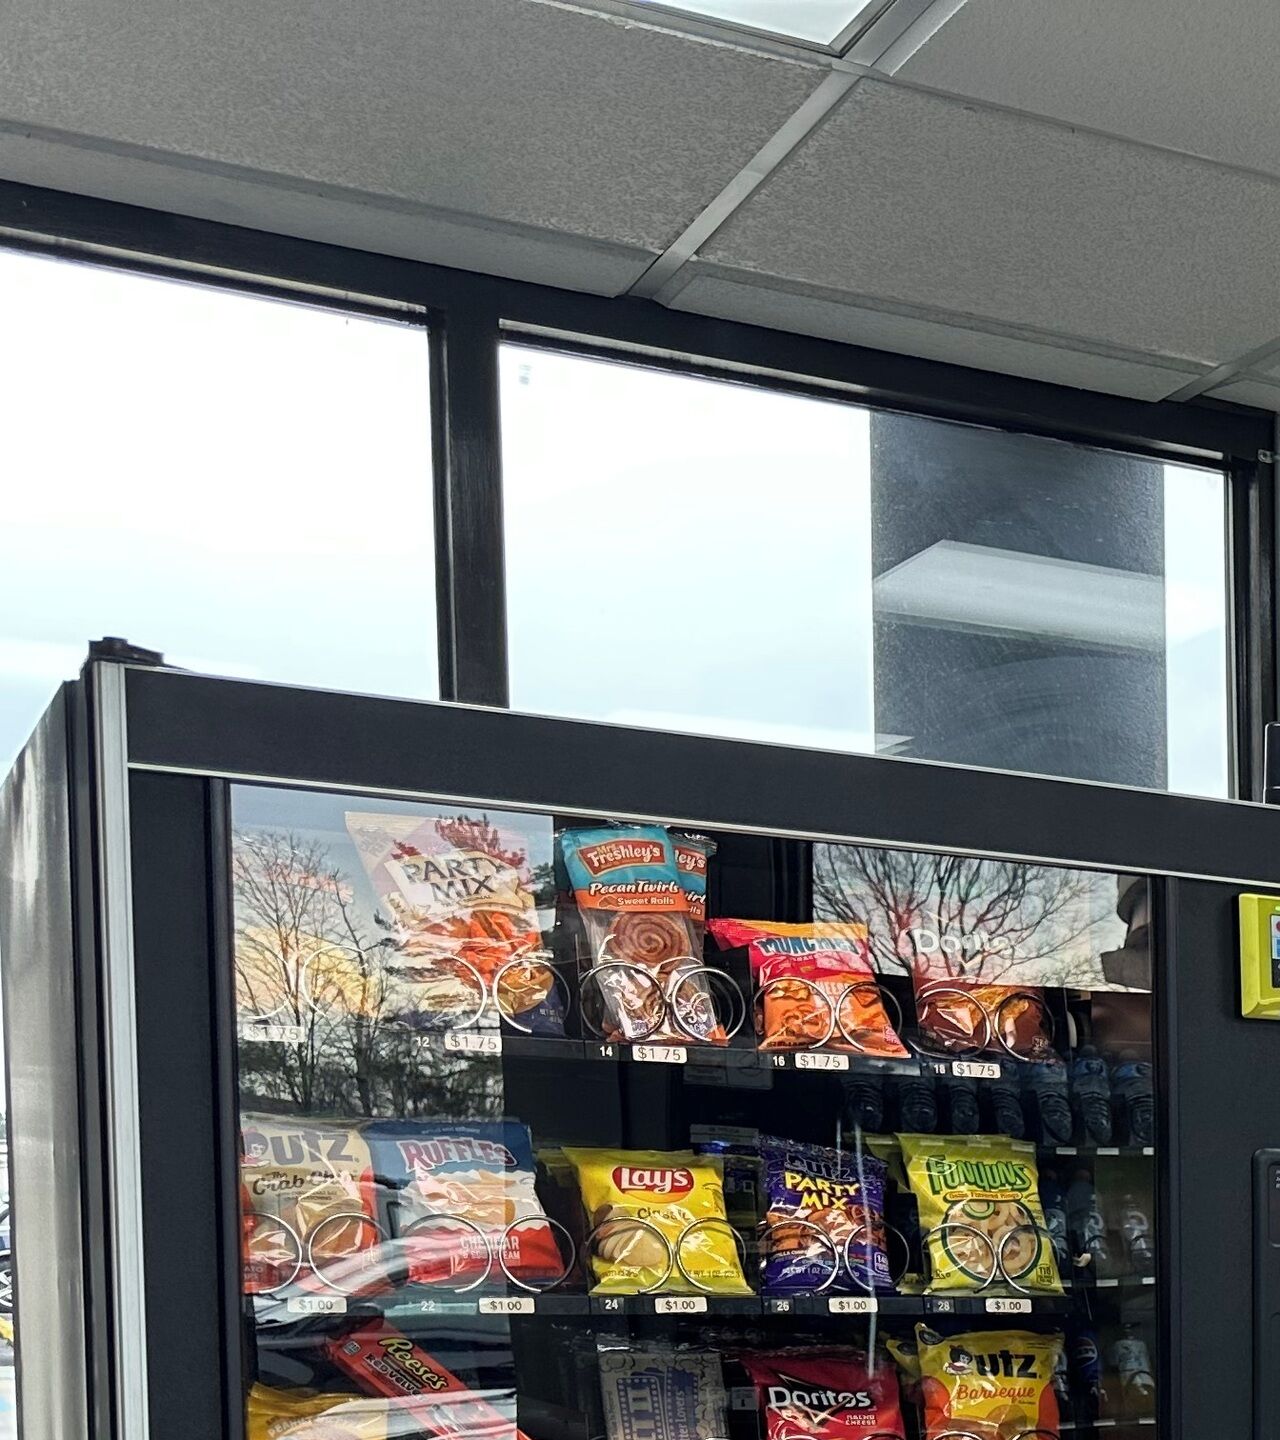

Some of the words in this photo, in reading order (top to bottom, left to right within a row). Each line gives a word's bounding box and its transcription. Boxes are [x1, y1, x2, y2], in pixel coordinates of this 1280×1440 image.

[588, 843, 661, 868] Freshley's
[430, 876, 496, 904] MIX
[600, 1046, 613, 1056] 14
[772, 1055, 785, 1066] 16
[800, 1055, 841, 1068] $1.75
[957, 1064, 996, 1077] $1.75
[621, 1166, 690, 1195] Lay's
[784, 1171, 860, 1196] PARTY
[926, 1155, 1032, 1195] FUNYUNS
[800, 1192, 849, 1211] MIX
[421, 1301, 435, 1311] 22
[490, 1300, 521, 1311] $1.00
[605, 1300, 618, 1310] 24
[665, 1300, 696, 1311] $1.00
[777, 1302, 789, 1312] 26
[838, 1300, 867, 1311] $1.00
[938, 1302, 950, 1312] 28
[994, 1301, 1021, 1311] $1.00
[378, 1337, 450, 1392] Reese's
[768, 1385, 872, 1408] Doritos
